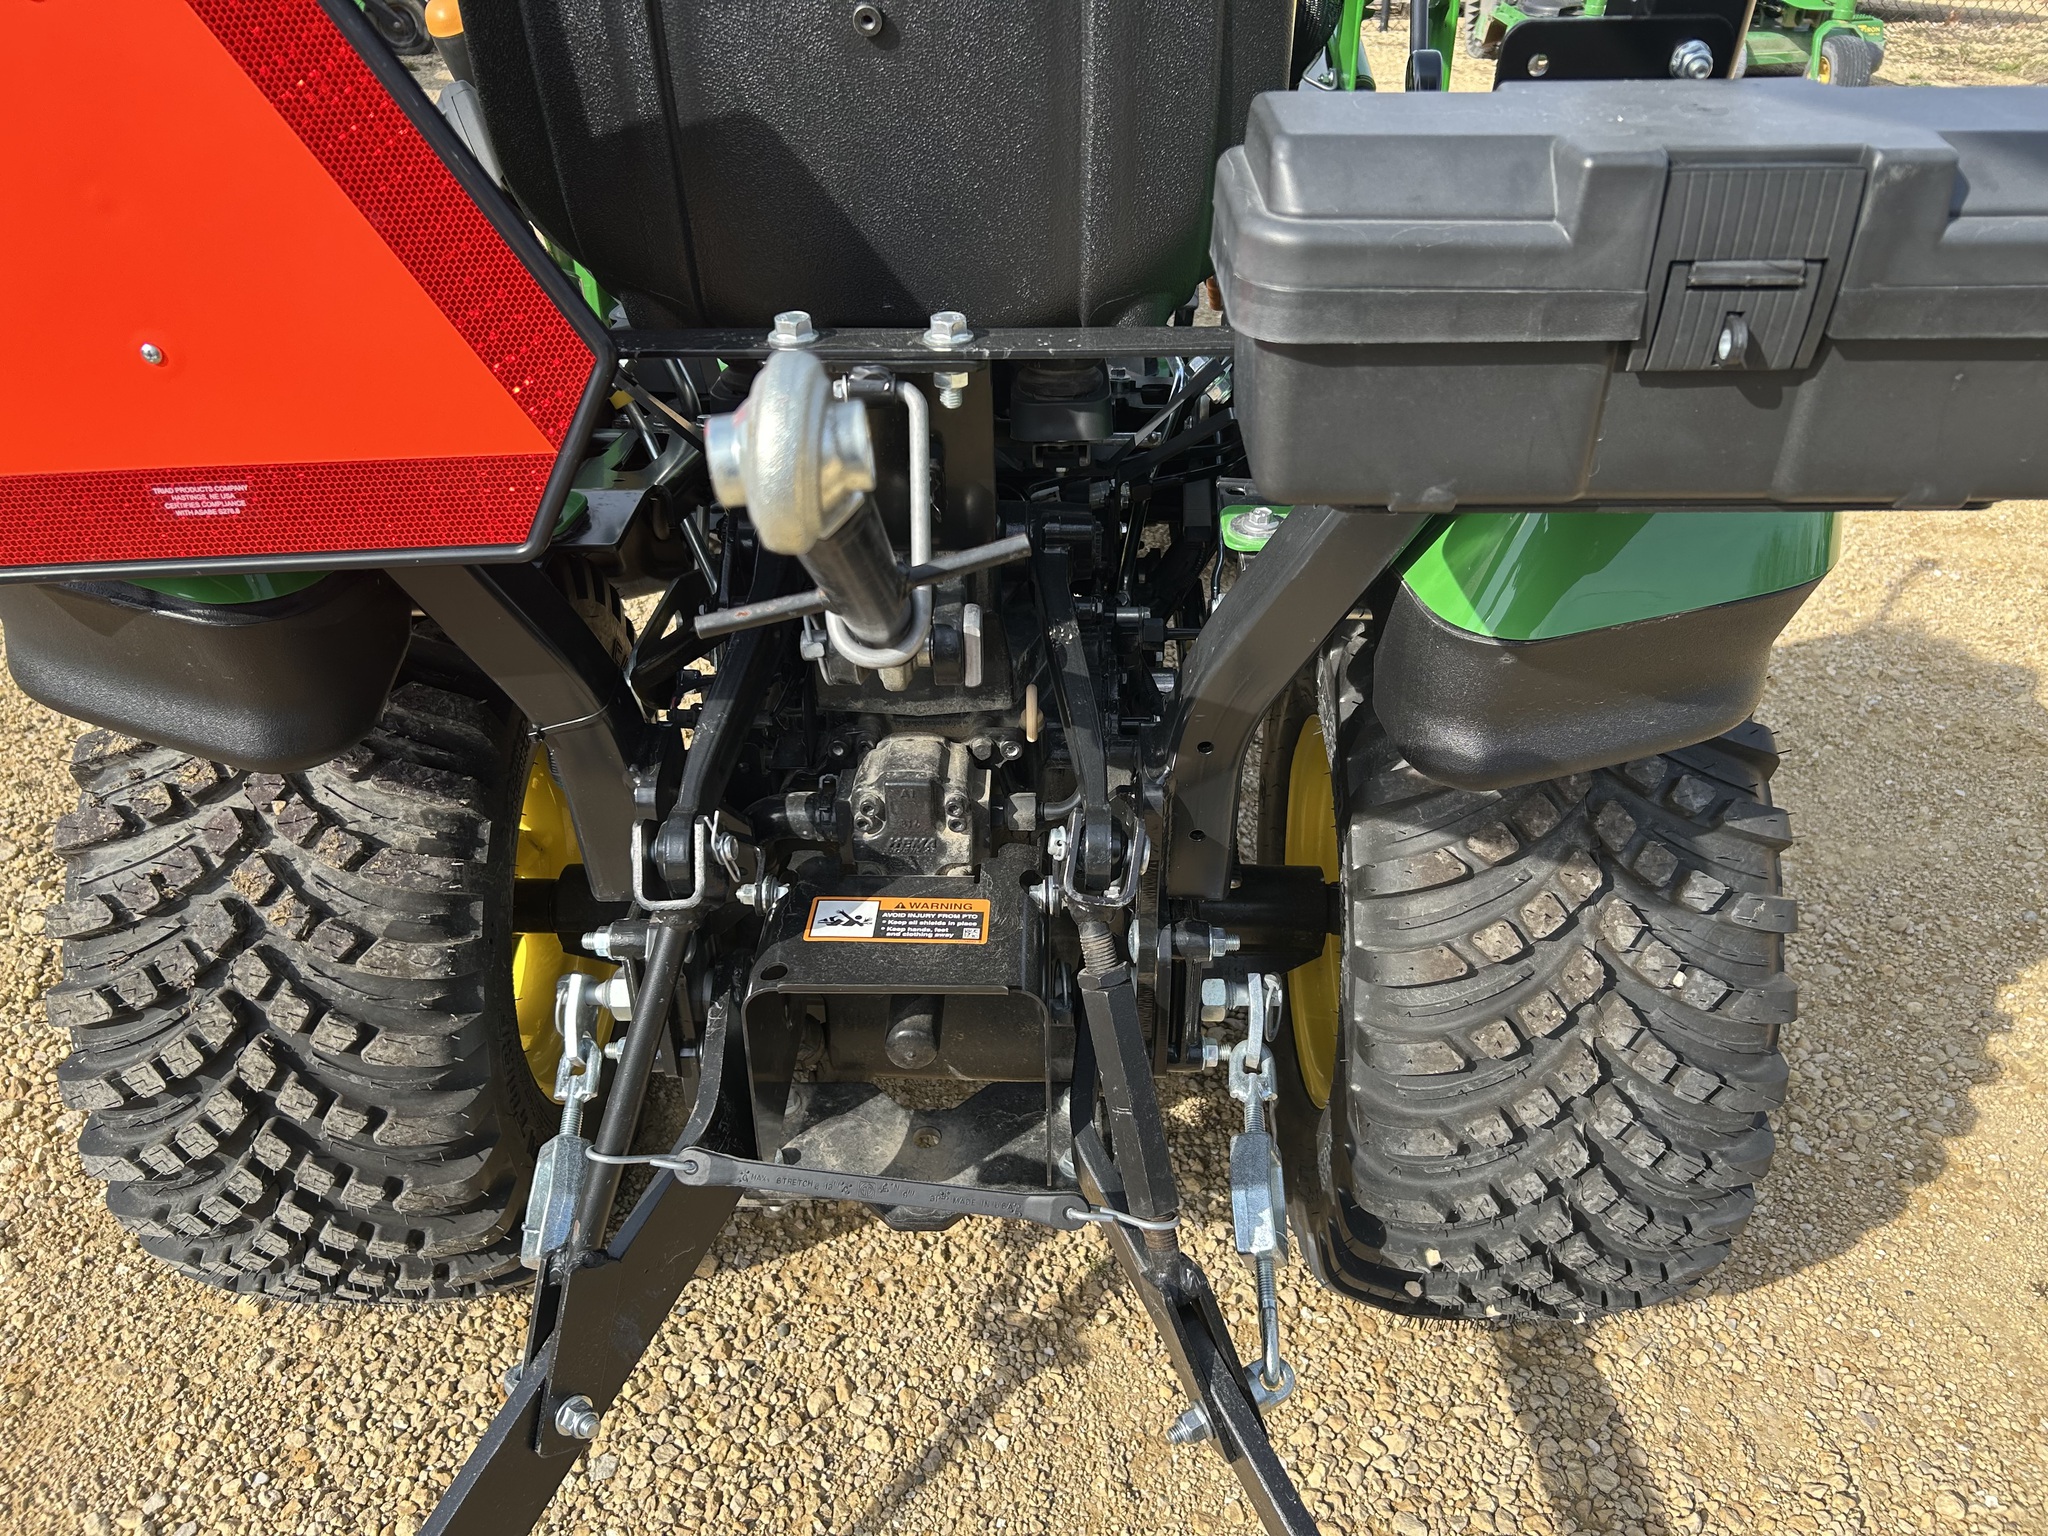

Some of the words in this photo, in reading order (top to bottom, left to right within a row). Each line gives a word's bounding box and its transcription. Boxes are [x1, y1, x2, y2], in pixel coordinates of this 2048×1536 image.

[152, 487, 174, 495] TRIAD
[175, 485, 214, 494] PRODUCTS
[214, 484, 248, 492] COMPANY
[220, 492, 236, 500] USA
[164, 501, 200, 509] CERTIFIES
[201, 499, 247, 508] COMPLIANCE
[909, 902, 973, 910] WARNING
